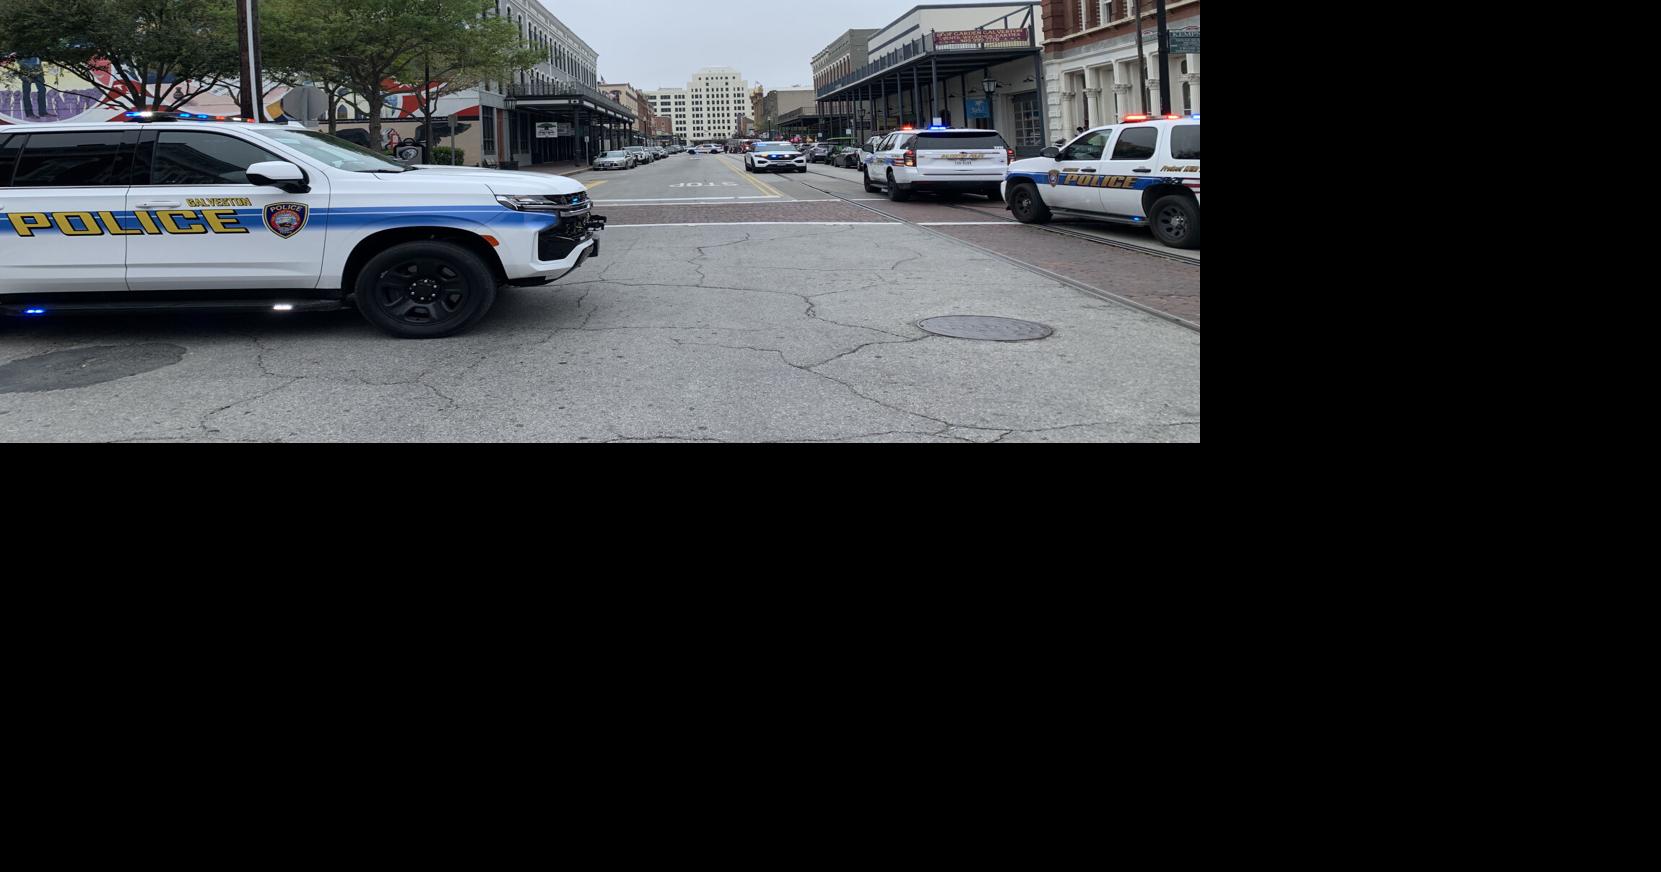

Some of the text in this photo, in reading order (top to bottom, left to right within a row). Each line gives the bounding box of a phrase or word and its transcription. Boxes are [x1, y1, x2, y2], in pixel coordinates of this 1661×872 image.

[1064, 173, 1137, 188] POLICE
[186, 197, 252, 207] GALVESTON
[270, 204, 303, 212] POLICE
[7, 208, 250, 237] POLICE
